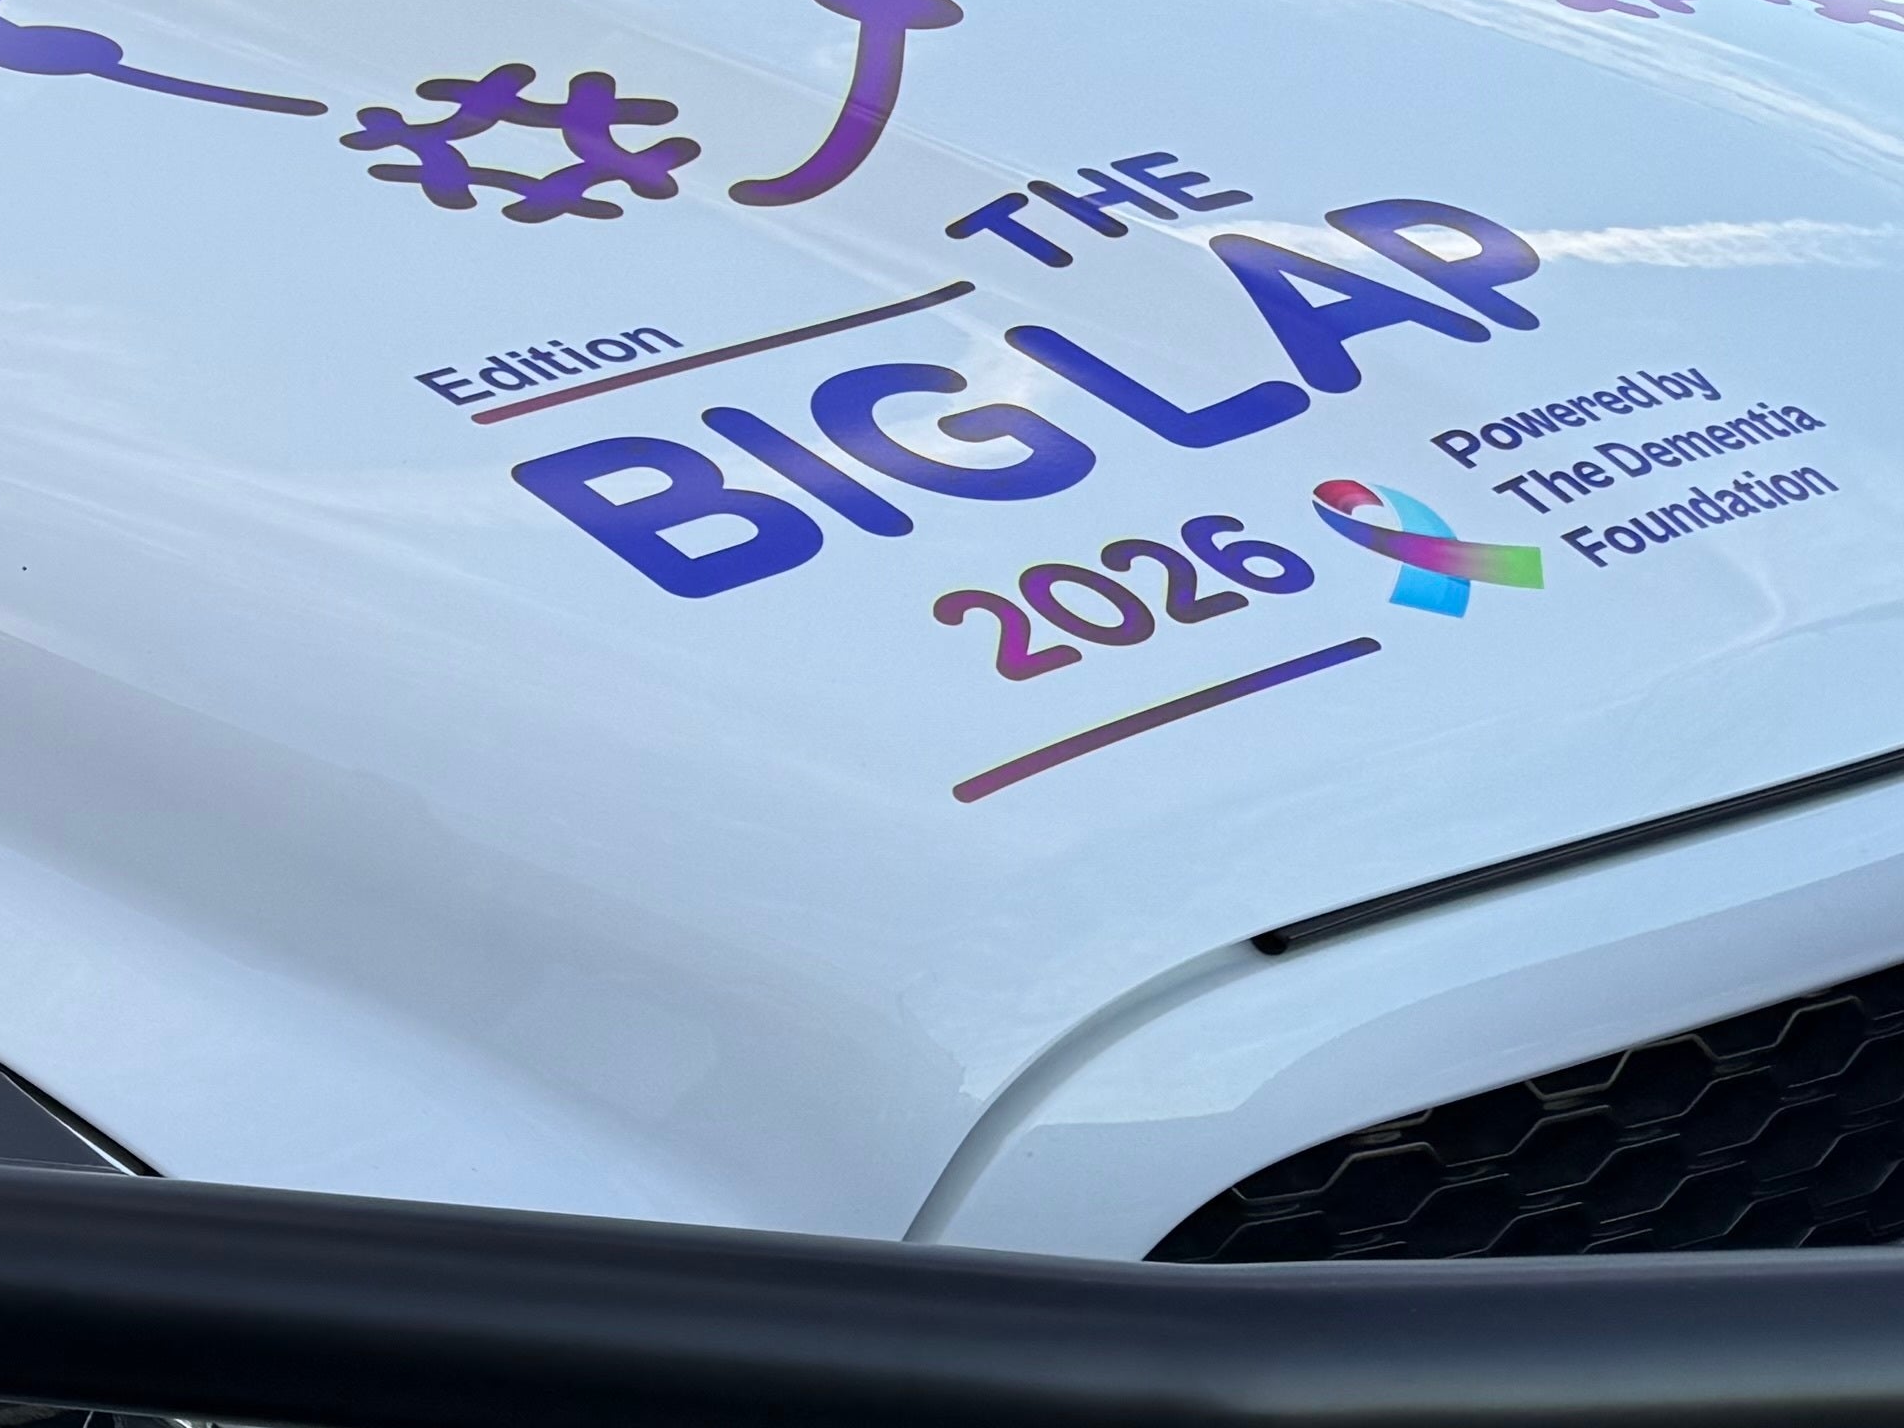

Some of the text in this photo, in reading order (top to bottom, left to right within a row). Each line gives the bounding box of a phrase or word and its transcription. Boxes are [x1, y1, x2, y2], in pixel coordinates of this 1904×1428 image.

[945, 150, 1253, 268] THE
[414, 326, 685, 407] Edition
[1429, 365, 1721, 470] Powered by
[1493, 400, 1827, 515] The Dementia
[1560, 460, 1840, 567] Foundation
[933, 514, 1315, 682] 2026
